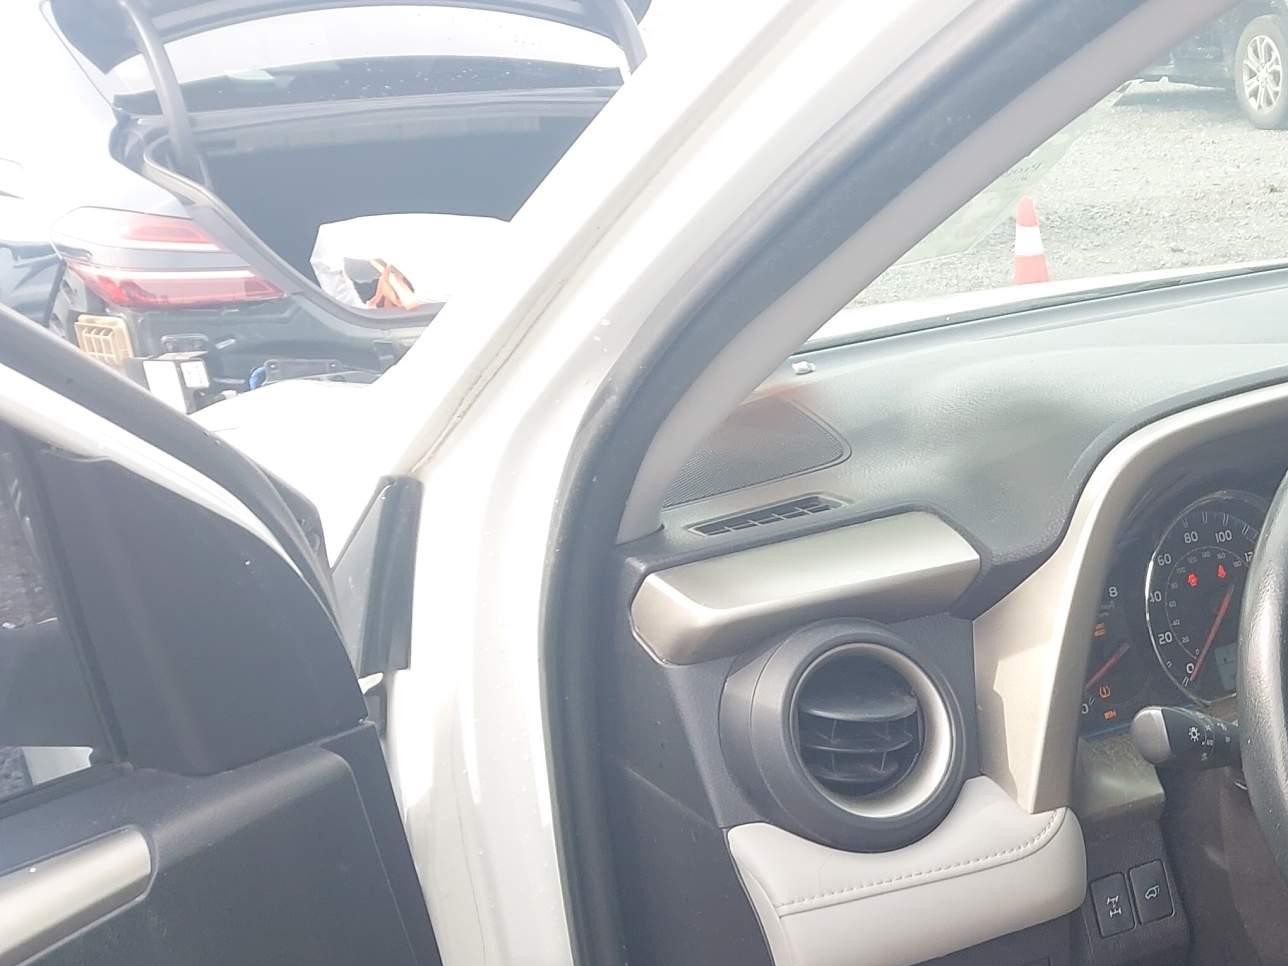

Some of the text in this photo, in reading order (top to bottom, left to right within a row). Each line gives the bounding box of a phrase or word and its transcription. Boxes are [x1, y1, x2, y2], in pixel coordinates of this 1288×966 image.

[1183, 531, 1199, 544] 80
[1215, 529, 1233, 543] 100
[1157, 553, 1172, 567] 60
[1108, 586, 1119, 598] 8
[1157, 631, 1173, 645] 20
[1186, 662, 1195, 674] 0
